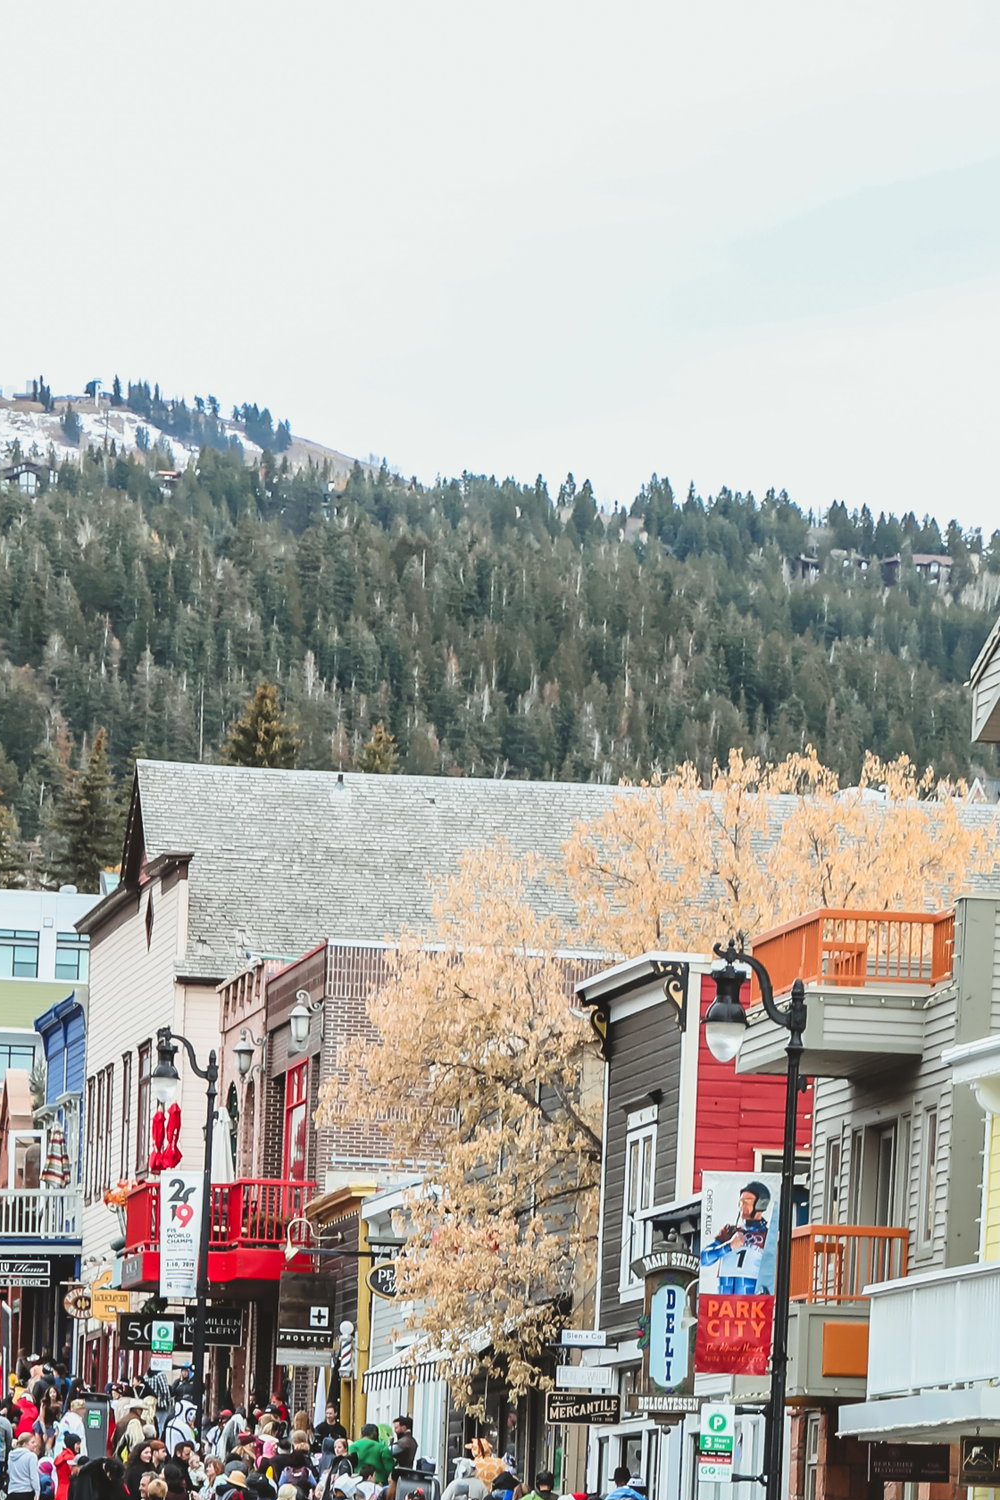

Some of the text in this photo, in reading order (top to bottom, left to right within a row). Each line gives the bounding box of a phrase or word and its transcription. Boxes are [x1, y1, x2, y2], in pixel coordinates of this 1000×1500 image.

[13, 1263, 45, 1273] Home
[642, 1252, 668, 1271] MAIN
[736, 1250, 747, 1268] 1
[707, 1300, 766, 1319] PARK
[664, 1289, 676, 1381] DELI
[707, 1319, 766, 1337] CITY
[279, 1334, 331, 1343] PROSPECT
[549, 1400, 618, 1420] MERCANTILE
[638, 1397, 699, 1411] DELICATESSEN
[713, 1416, 724, 1431] P
[704, 1436, 712, 1449] 3
